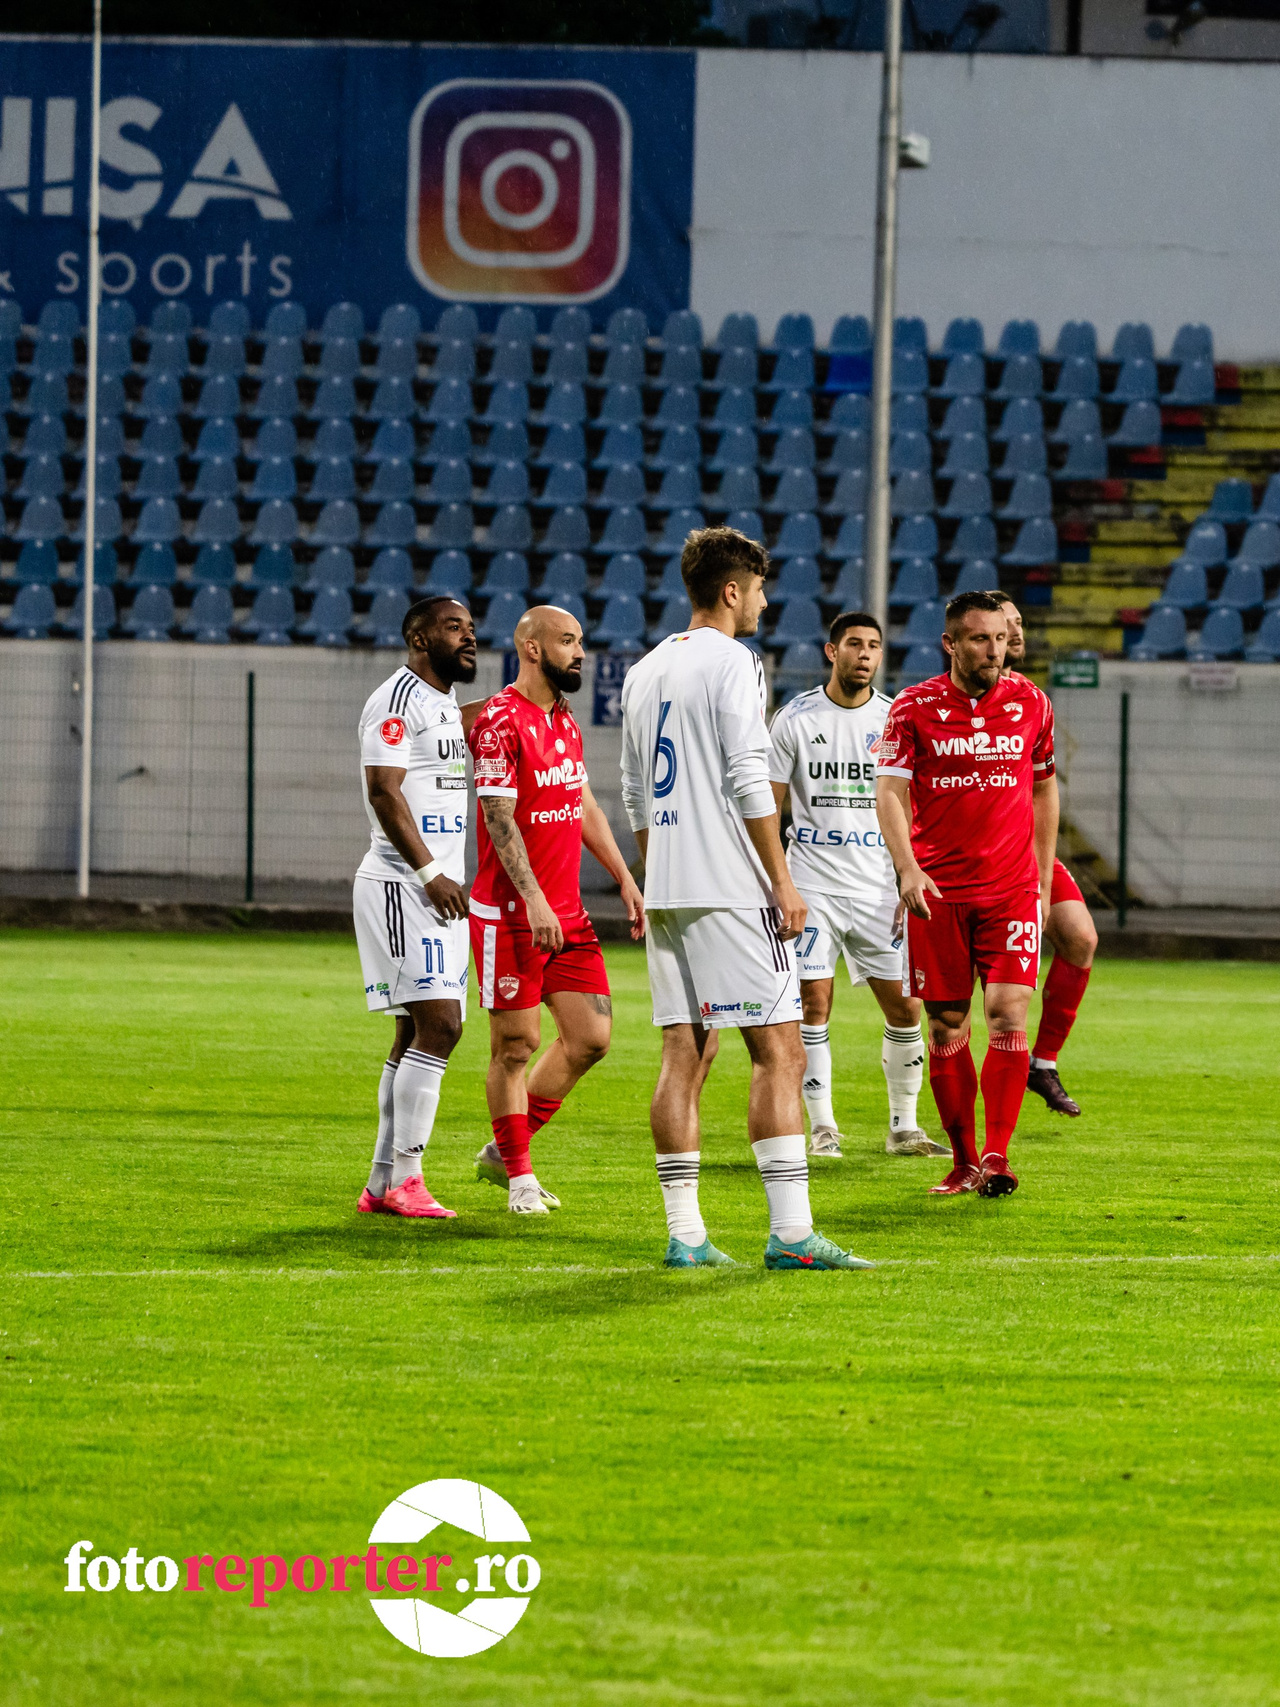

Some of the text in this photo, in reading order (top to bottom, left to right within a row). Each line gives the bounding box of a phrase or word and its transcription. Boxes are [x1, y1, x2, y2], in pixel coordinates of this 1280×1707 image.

[654, 700, 678, 799] 6
[931, 731, 1024, 757] WIN2.RO
[851, 799, 870, 808] SPRE
[1006, 920, 1037, 953] 23
[421, 937, 445, 974] 11
[803, 963, 826, 971] Vestra
[711, 1001, 762, 1012] Smart Eco
